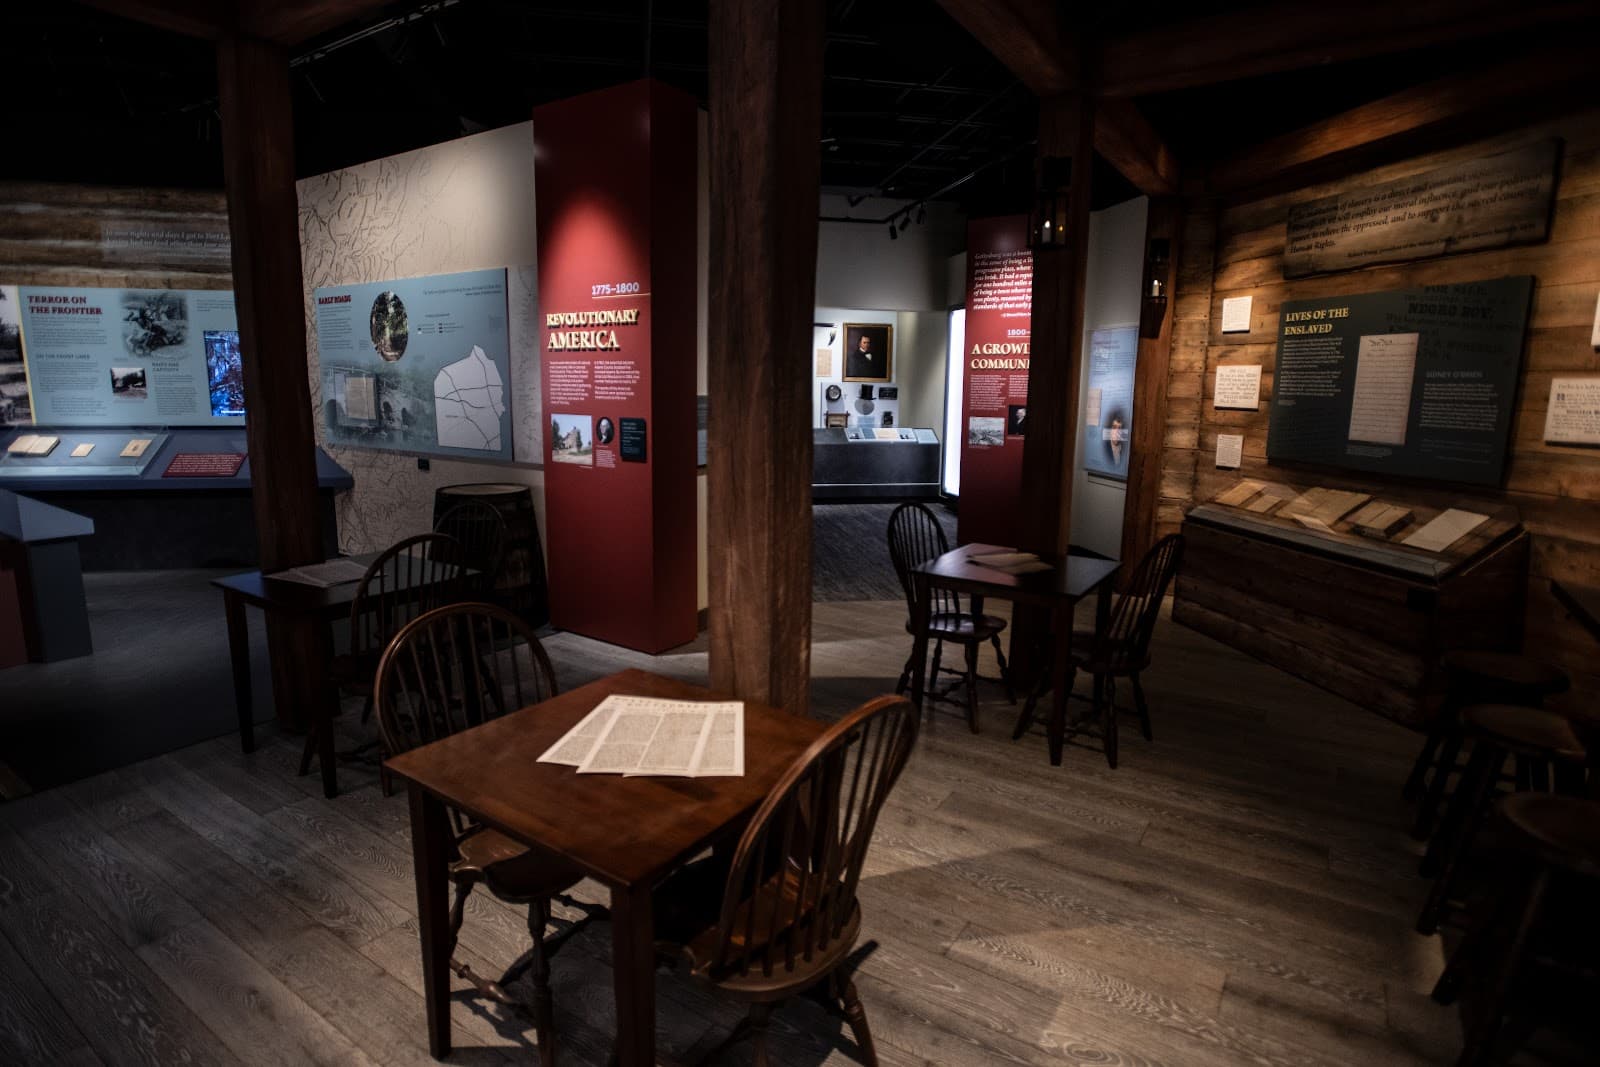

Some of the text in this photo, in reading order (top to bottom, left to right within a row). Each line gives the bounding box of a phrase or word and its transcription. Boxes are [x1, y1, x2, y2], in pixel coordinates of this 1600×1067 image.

[27, 295, 87, 305] TERROR ON
[30, 306, 104, 315] THE FRONTIER
[1285, 307, 1349, 323] LIVES OF THE
[546, 308, 639, 328] REVOLUTIONARY
[1284, 323, 1333, 336] ENSLAVED
[547, 329, 620, 351] AMERICA
[971, 342, 981, 355] A
